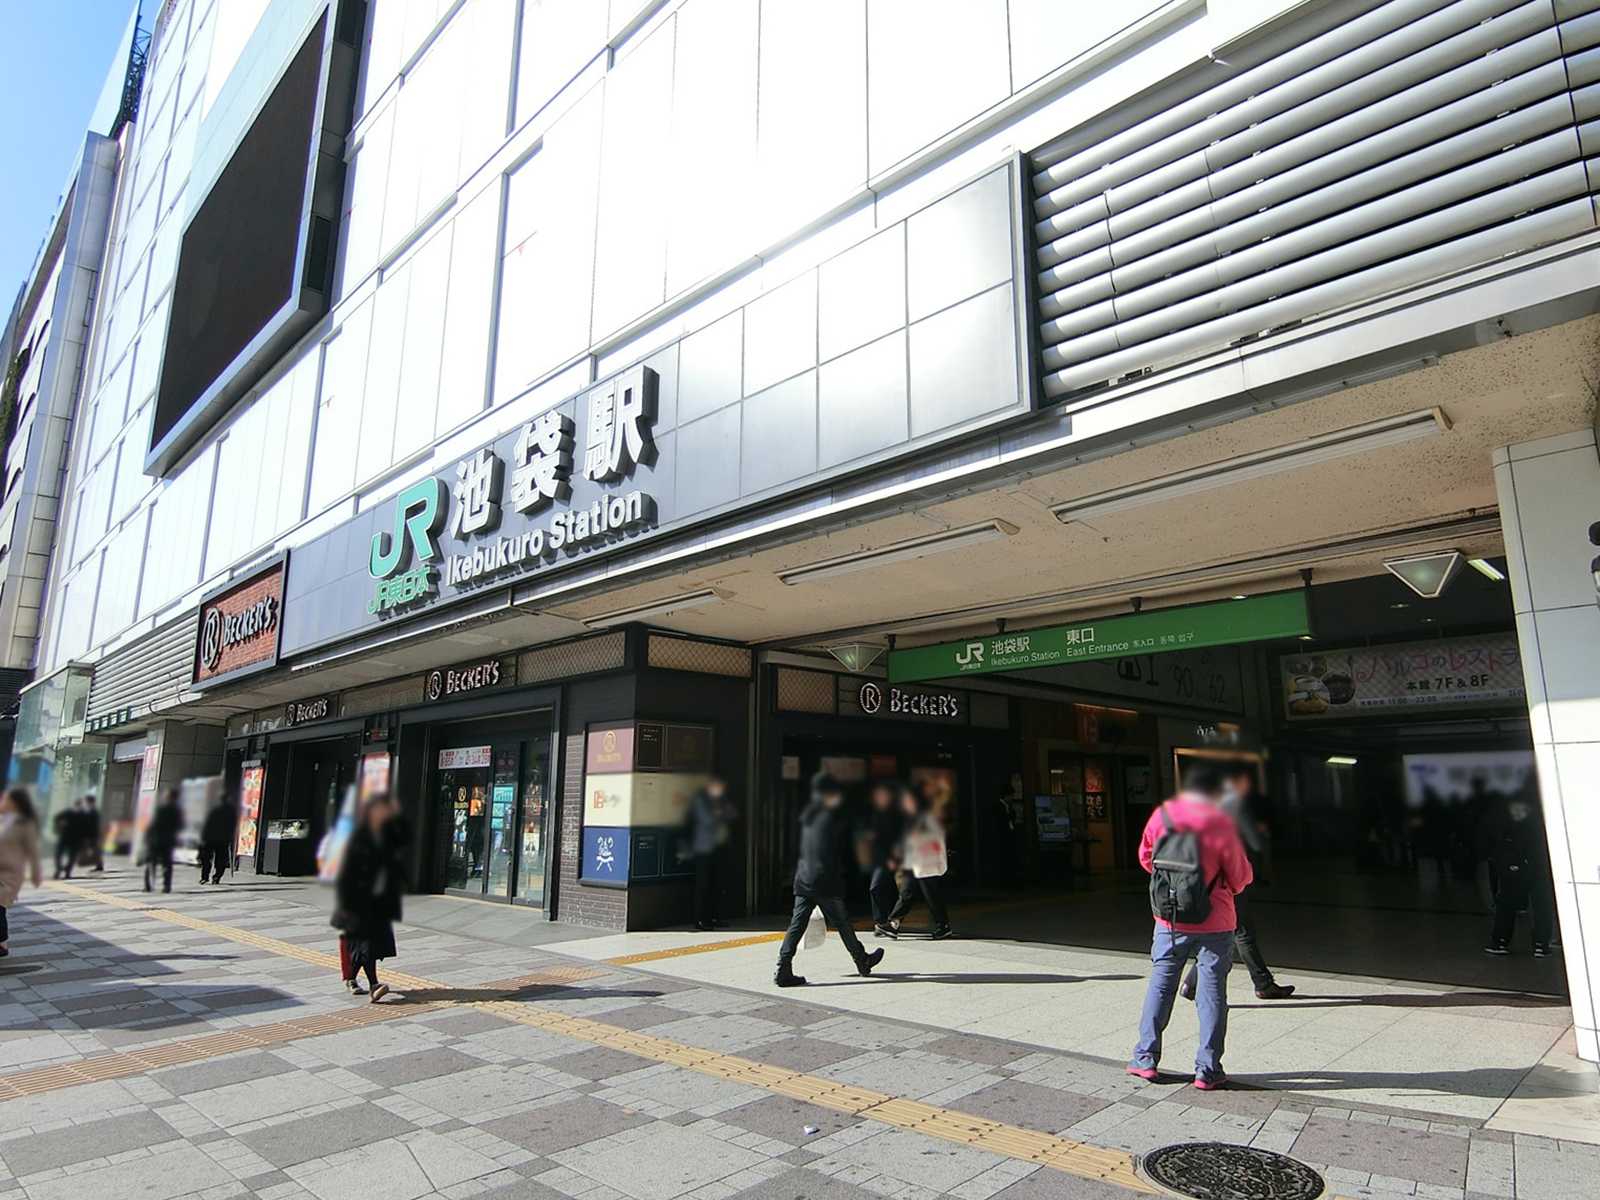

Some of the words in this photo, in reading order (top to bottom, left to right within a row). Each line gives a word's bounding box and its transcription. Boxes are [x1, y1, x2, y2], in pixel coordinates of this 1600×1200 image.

[451, 366, 648, 538] 池袋駅
[369, 476, 440, 579] JR
[446, 528, 544, 587] Ikebukuro
[550, 491, 642, 549] Station
[367, 563, 432, 614] JR東日本
[224, 596, 273, 647] BECKER'S
[956, 642, 984, 665] JR
[991, 654, 1029, 666] Ikebukuro
[1031, 651, 1060, 662] Station
[1067, 647, 1087, 657] East
[1089, 642, 1129, 654] Entrance
[992, 636, 1030, 655] 池袋駅
[1066, 627, 1095, 645] 東口
[446, 661, 499, 694] BECKER'S
[1435, 678, 1453, 691] 7F
[1457, 677, 1467, 688] &
[1470, 674, 1489, 688] 8F
[891, 688, 958, 717] BECKER'S
